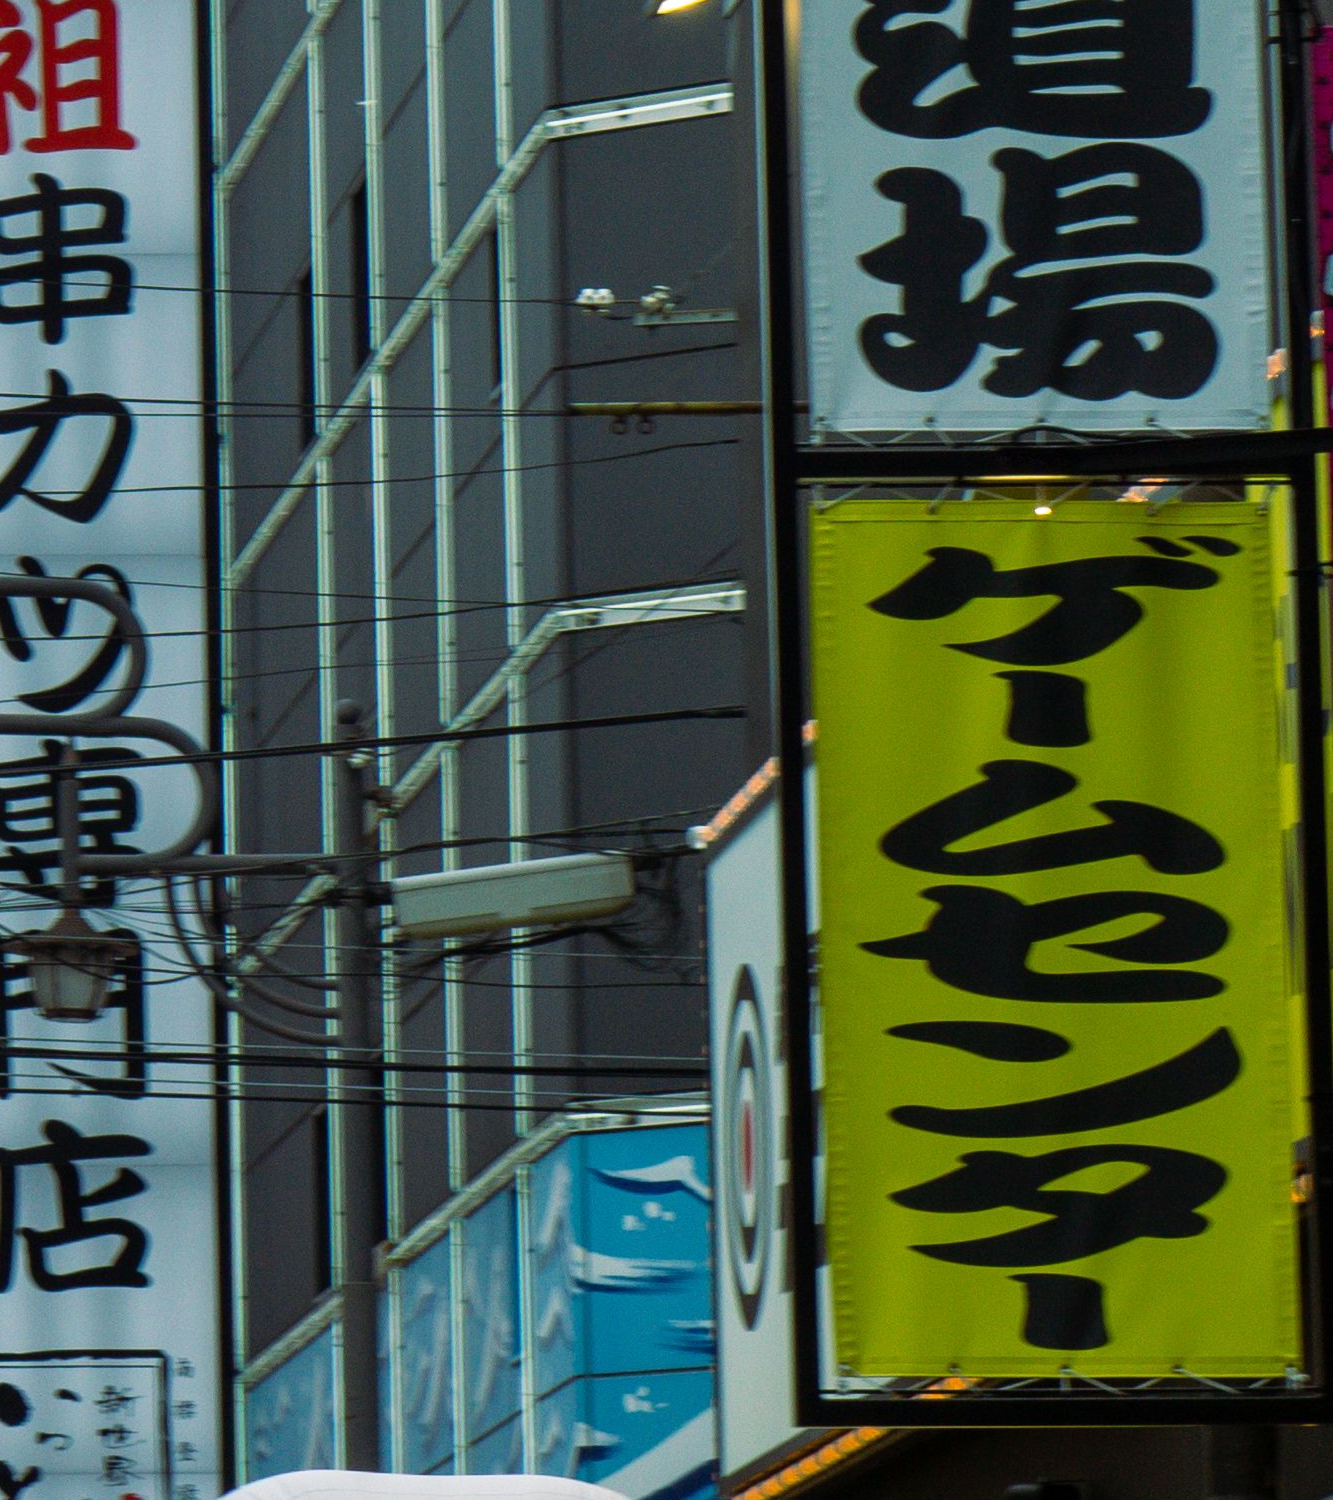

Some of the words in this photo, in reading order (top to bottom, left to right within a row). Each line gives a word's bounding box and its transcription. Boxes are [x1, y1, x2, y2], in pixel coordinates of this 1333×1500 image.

[858, 535, 1245, 1351] ゲームセンター
